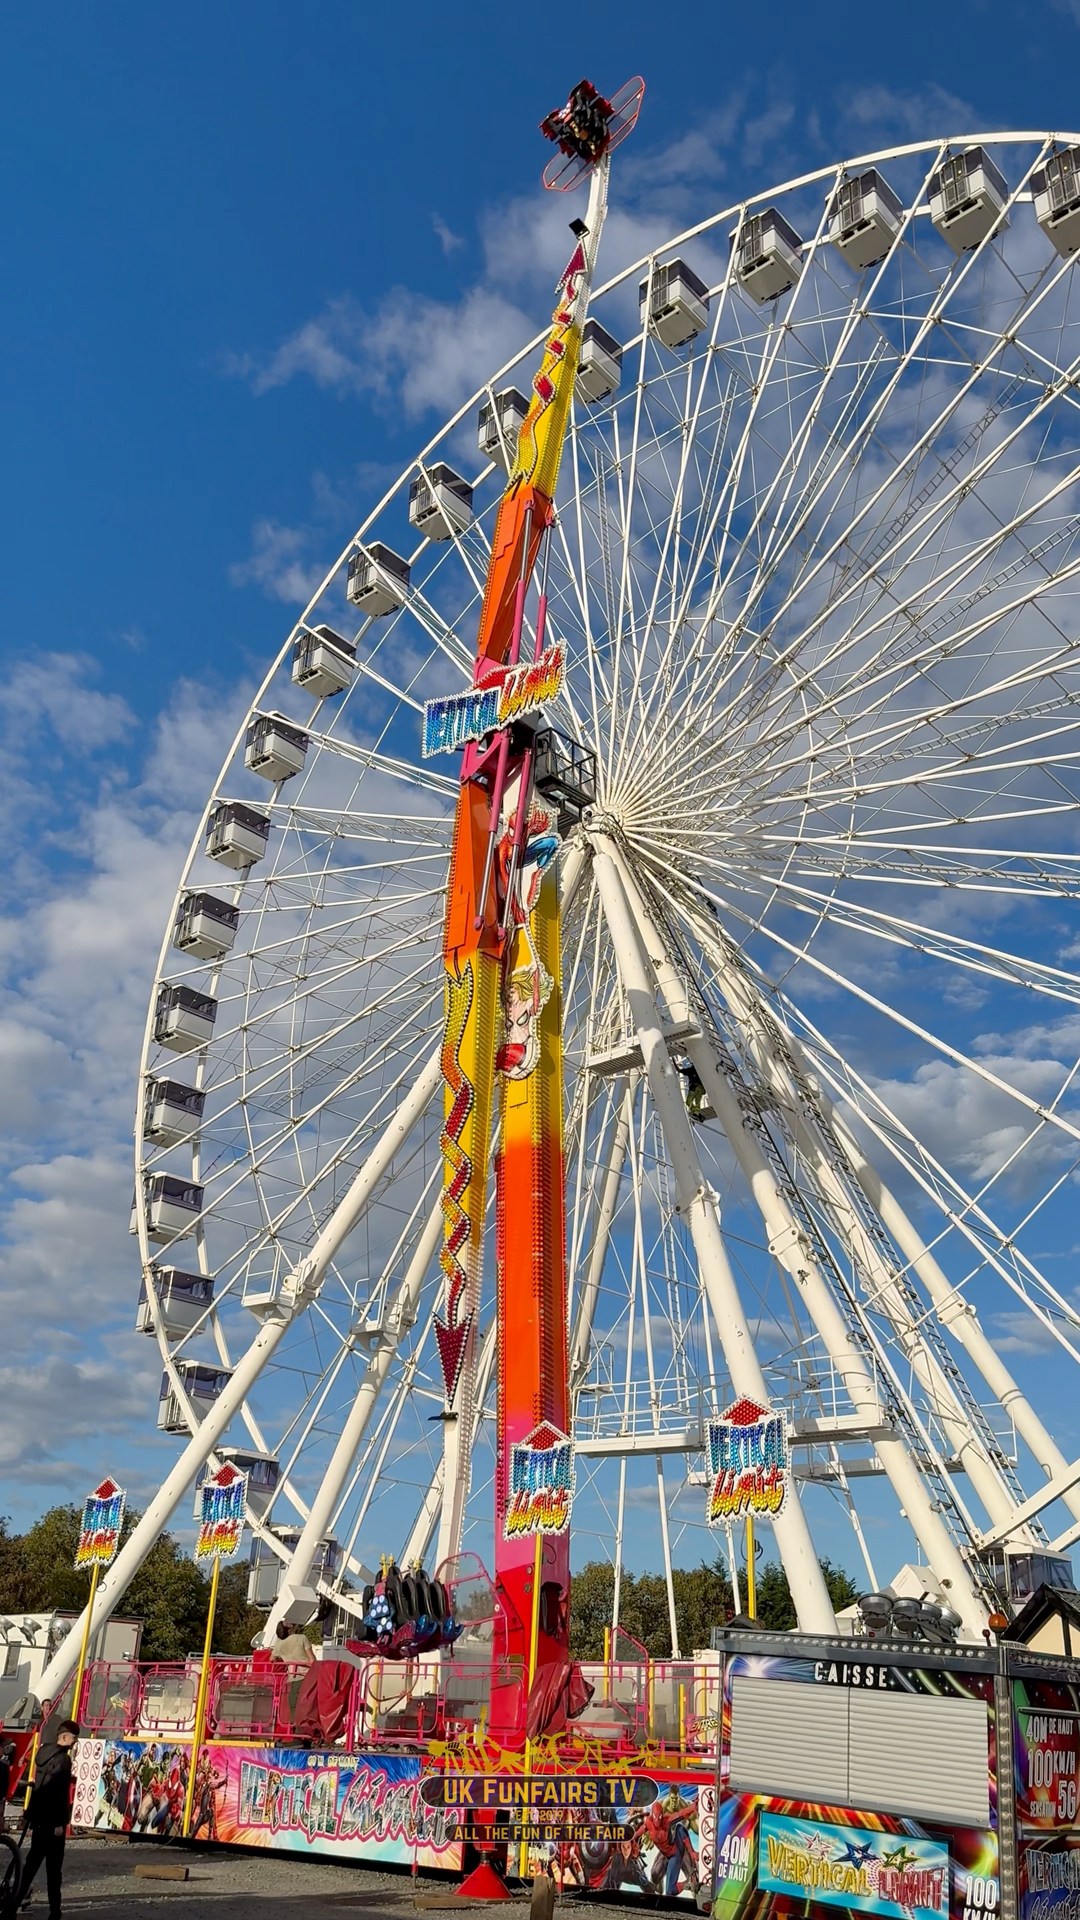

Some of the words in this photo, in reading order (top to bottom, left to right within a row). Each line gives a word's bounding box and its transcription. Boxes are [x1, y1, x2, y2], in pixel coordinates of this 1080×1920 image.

[709, 1417, 787, 1476] VERTICAL
[814, 1661, 888, 1688] CAISSE
[1026, 1715, 1048, 1743] 40M
[1049, 1718, 1057, 1734] DE
[1058, 1719, 1074, 1735] HAUT
[1028, 1749, 1053, 1788] 100
[1053, 1750, 1076, 1775] KM/H
[241, 1762, 339, 1836] VERTICAL
[1058, 1780, 1077, 1819] 5G
[720, 1834, 750, 1867] 40M
[767, 1834, 873, 1897] VERTICAL
[718, 1863, 728, 1878] DE
[729, 1865, 748, 1882] HAUT
[965, 1875, 997, 1910] 100
